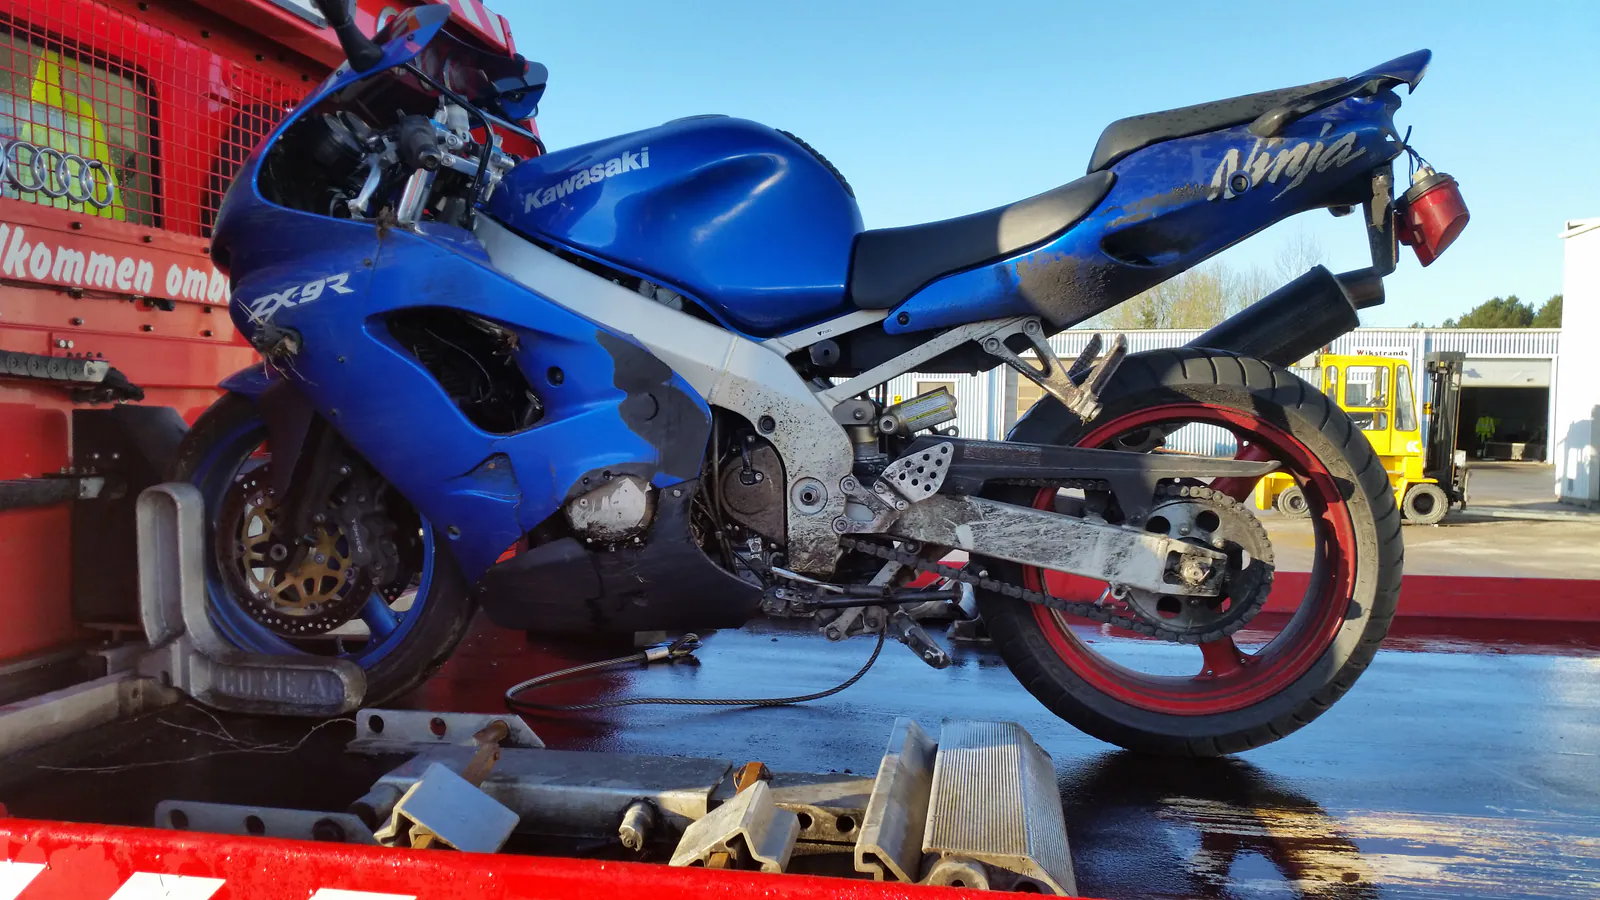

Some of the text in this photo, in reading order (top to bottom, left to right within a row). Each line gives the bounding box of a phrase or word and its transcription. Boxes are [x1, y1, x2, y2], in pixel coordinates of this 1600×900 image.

[524, 146, 649, 214] Kawasaki
[1206, 122, 1367, 201] Ninja
[248, 272, 354, 323] ZX-9R
